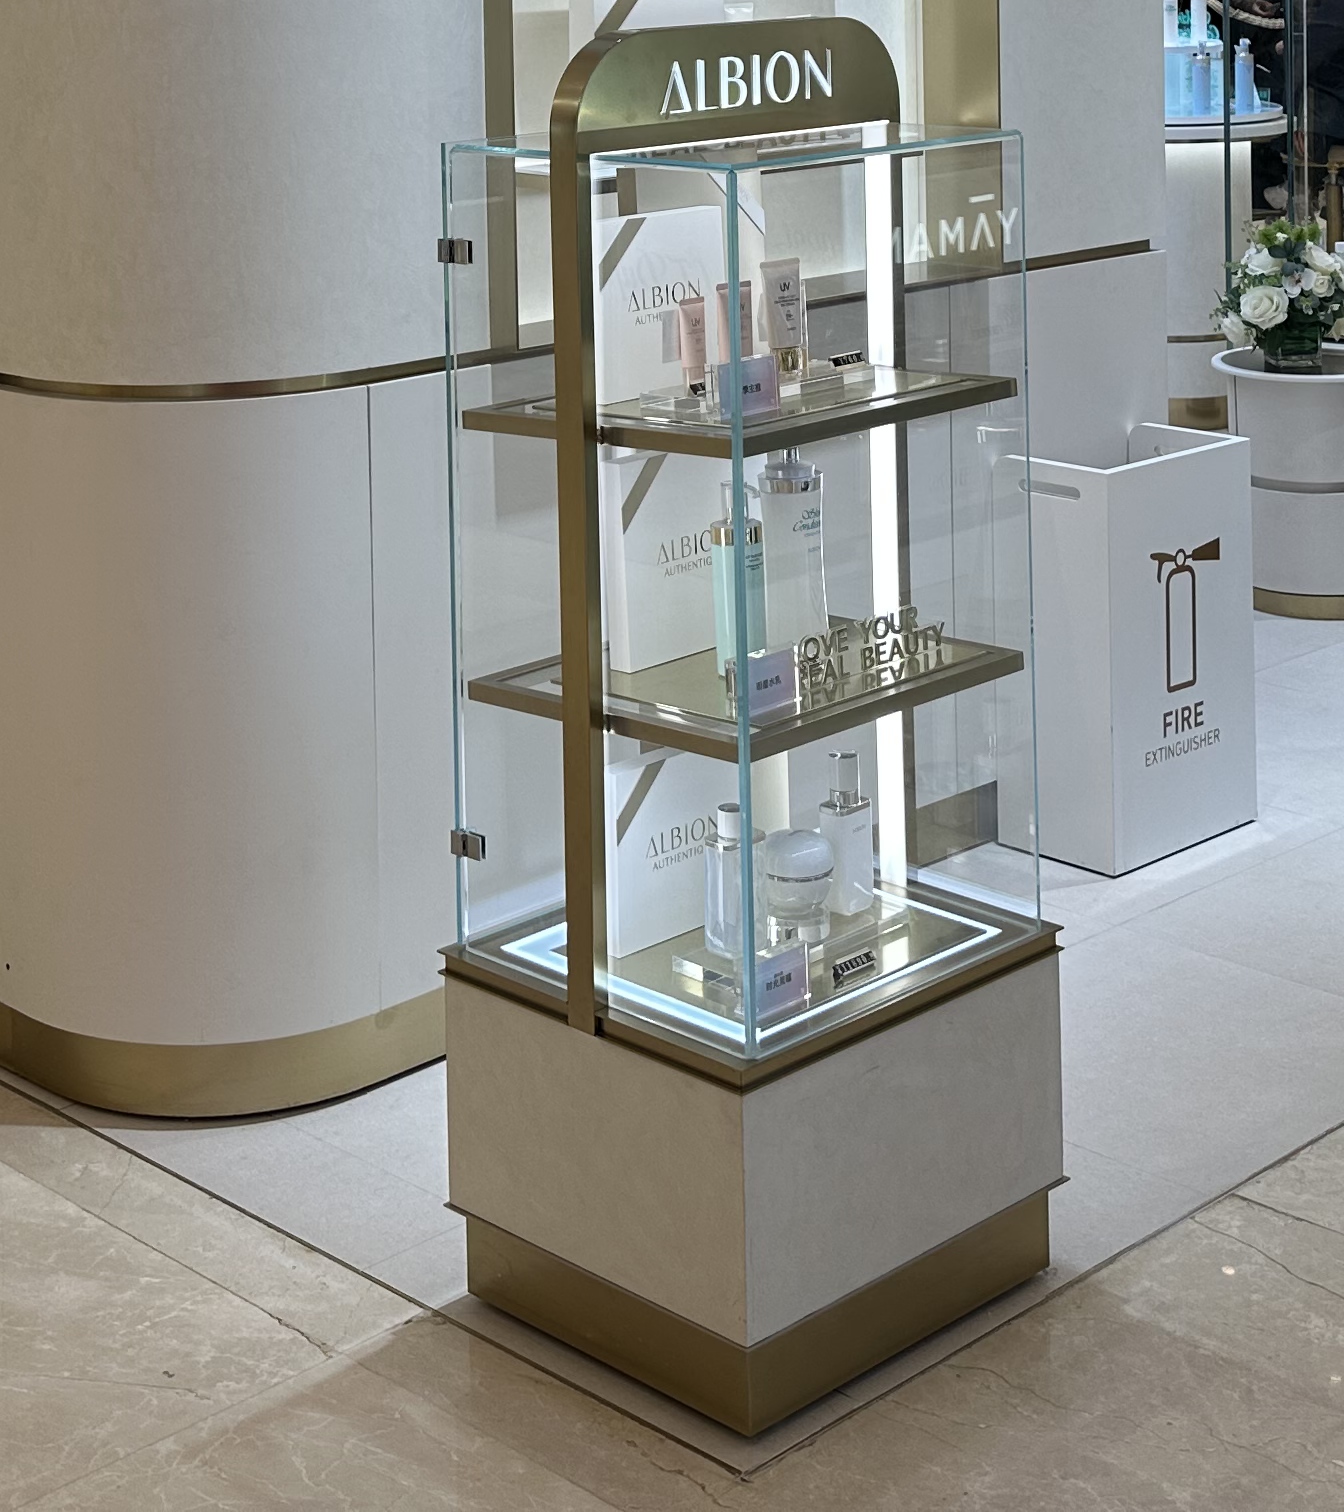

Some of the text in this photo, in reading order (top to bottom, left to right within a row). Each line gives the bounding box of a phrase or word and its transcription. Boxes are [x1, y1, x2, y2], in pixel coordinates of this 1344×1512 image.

[659, 47, 833, 117] ALBION
[628, 277, 701, 312] ALBION
[779, 281, 791, 292] UV
[657, 529, 712, 567] ALBIO
[664, 556, 713, 578] AUTHENTIQ
[801, 605, 919, 662] OVE YOUR
[861, 621, 945, 672] BEAUTY
[1163, 700, 1205, 738] FIRE
[1144, 728, 1221, 767] EXTINGUISHER
[652, 845, 704, 872] AUTHENTIQ
